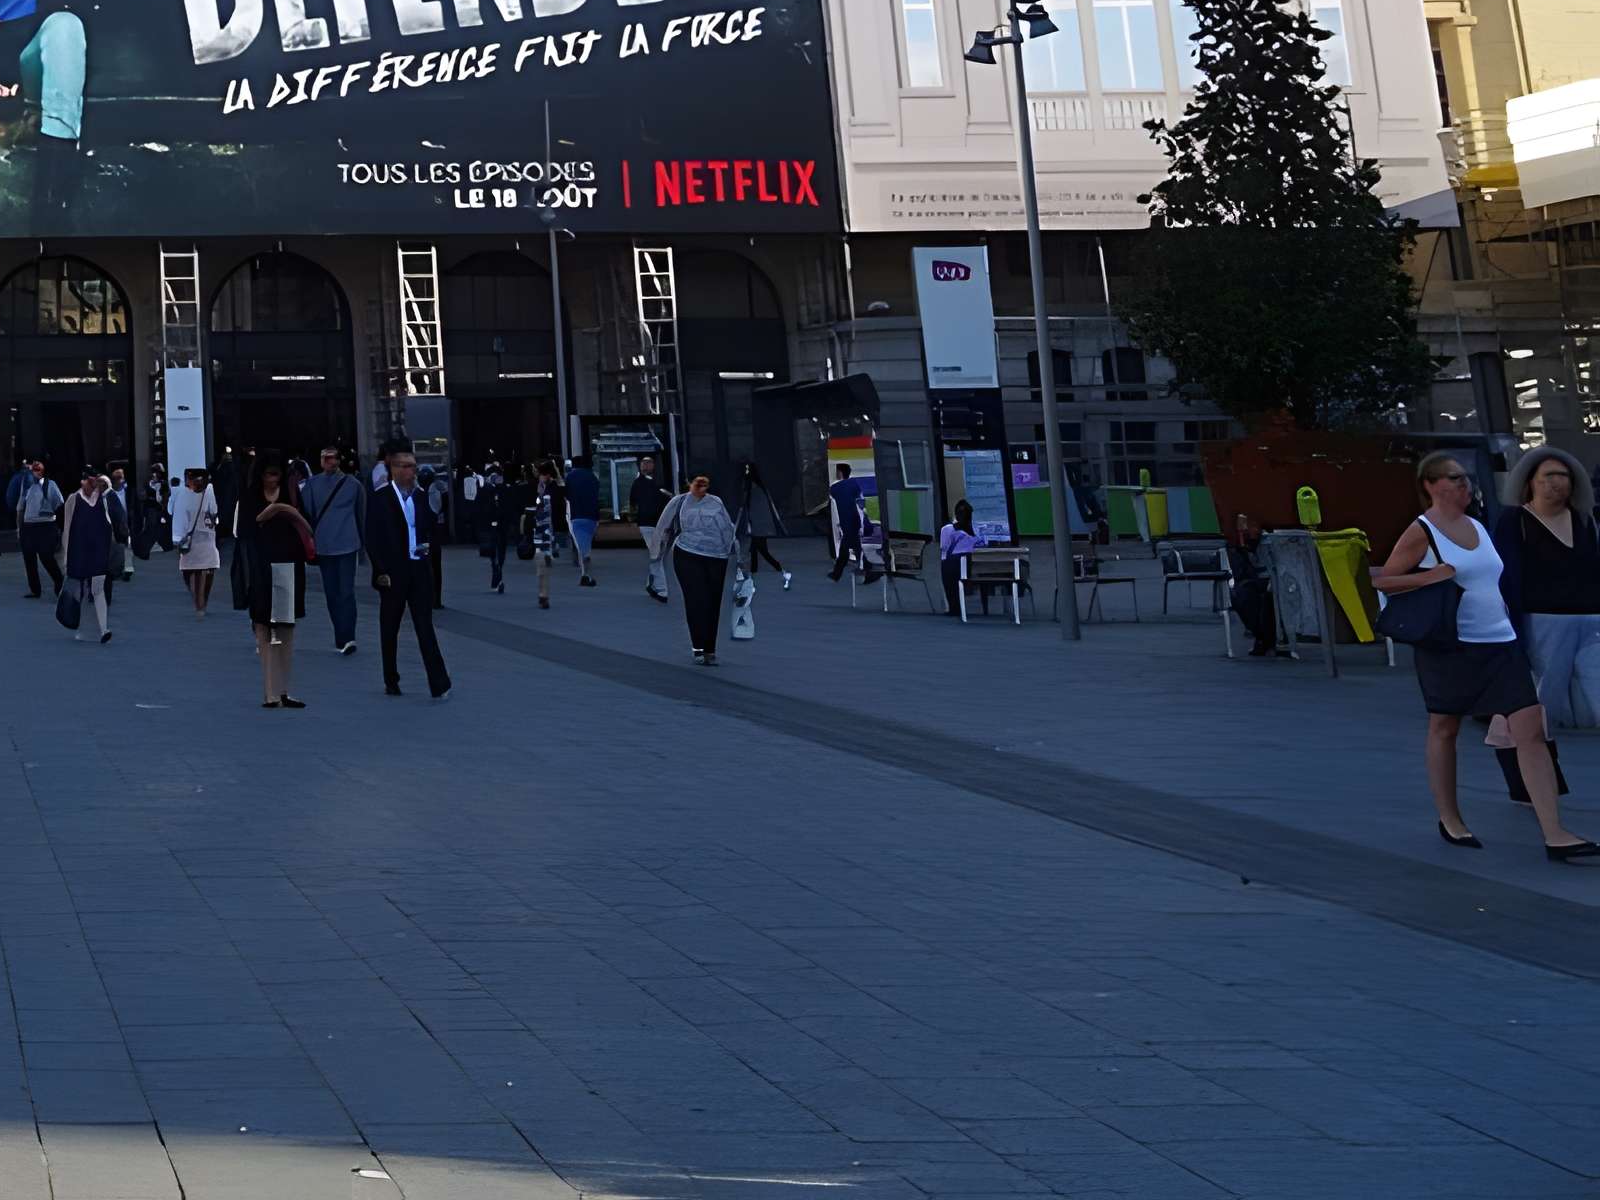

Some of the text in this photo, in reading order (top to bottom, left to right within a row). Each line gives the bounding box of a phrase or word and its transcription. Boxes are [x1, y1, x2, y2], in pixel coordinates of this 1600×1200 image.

[223, 78, 255, 114] LA
[266, 43, 501, 108] DIFFÉRENCE
[619, 23, 650, 58] LA
[661, 7, 766, 51] FORCE
[337, 163, 407, 184] TOUS
[414, 163, 461, 183] LES
[654, 160, 820, 207] NETFLIX
[454, 188, 486, 208] LE
